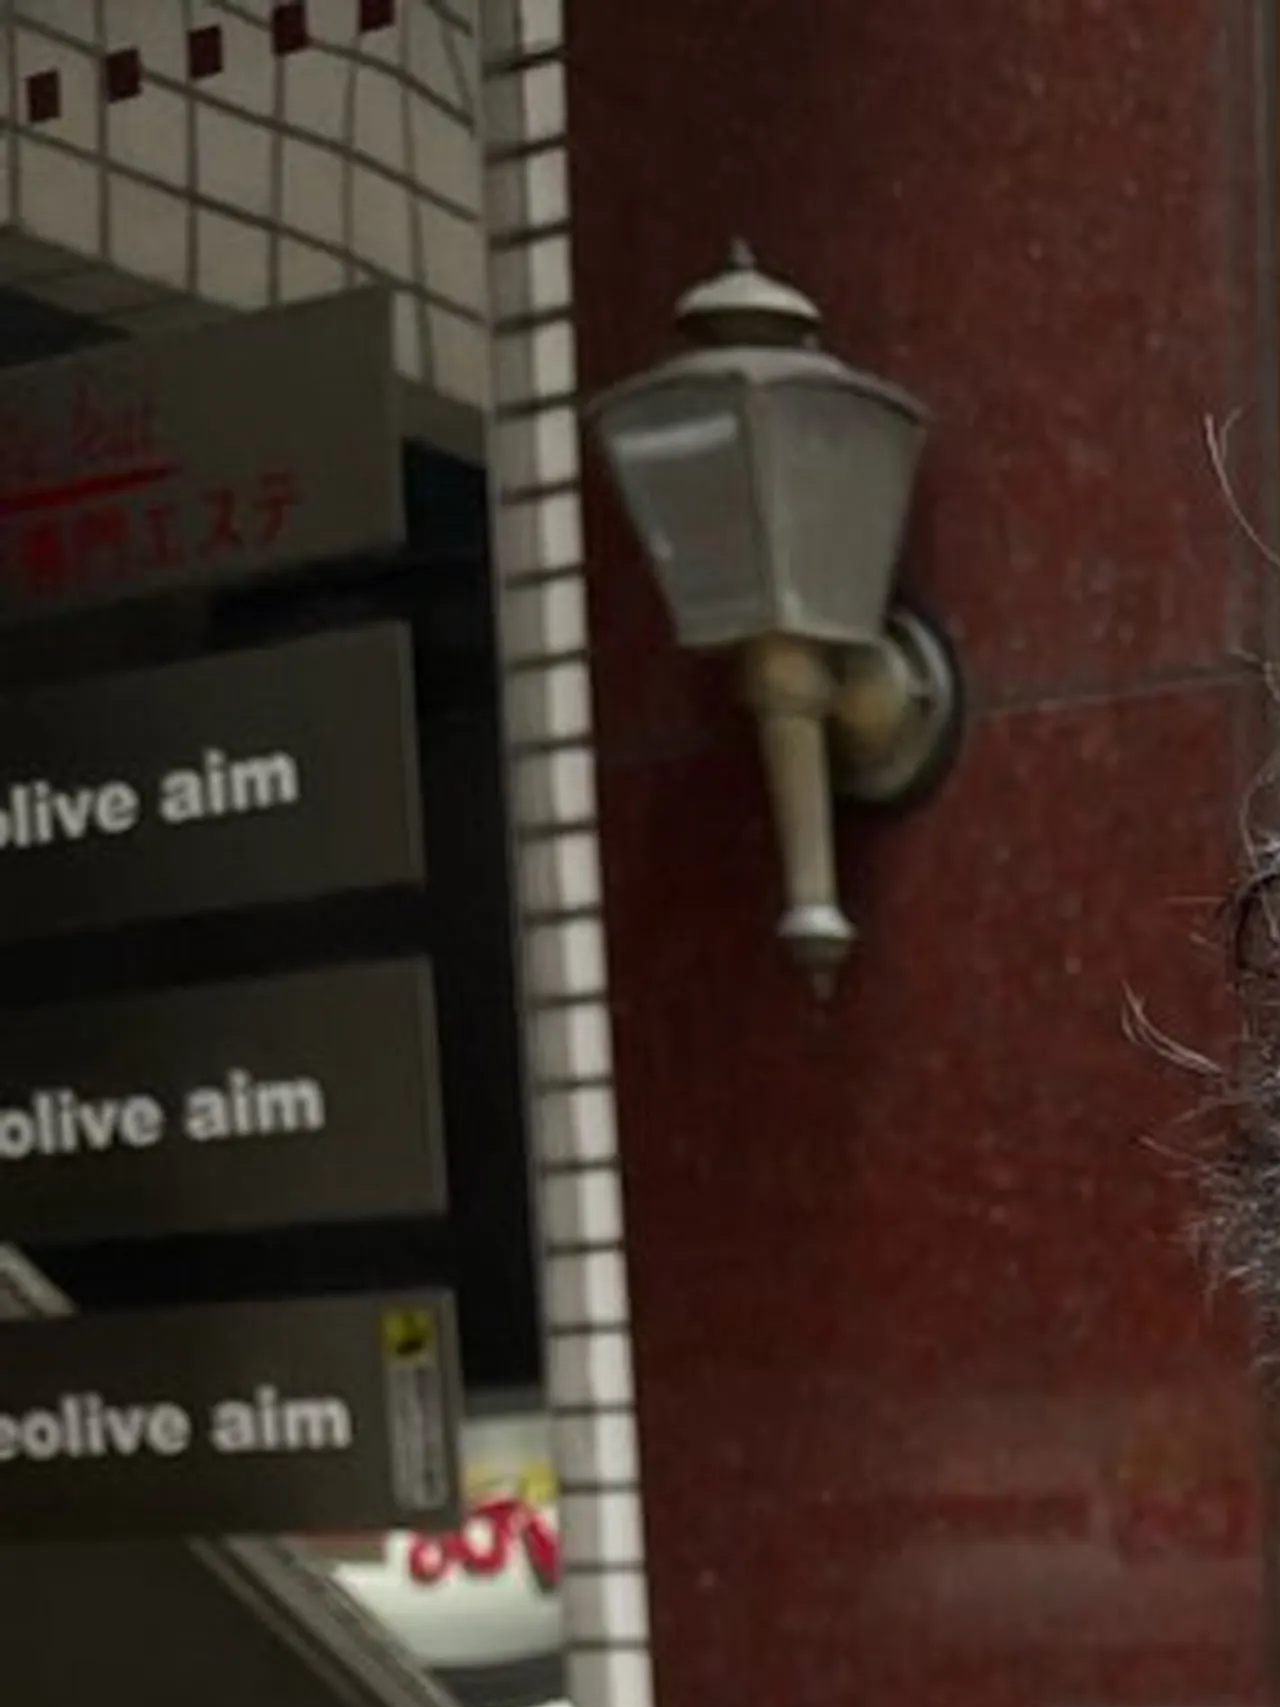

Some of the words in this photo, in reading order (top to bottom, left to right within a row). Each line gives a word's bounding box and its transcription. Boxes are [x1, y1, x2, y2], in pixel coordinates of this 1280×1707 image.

[0, 779, 140, 849] live
[159, 747, 300, 823] aim
[184, 1067, 325, 1142] aim
[211, 1384, 353, 1454] aim
